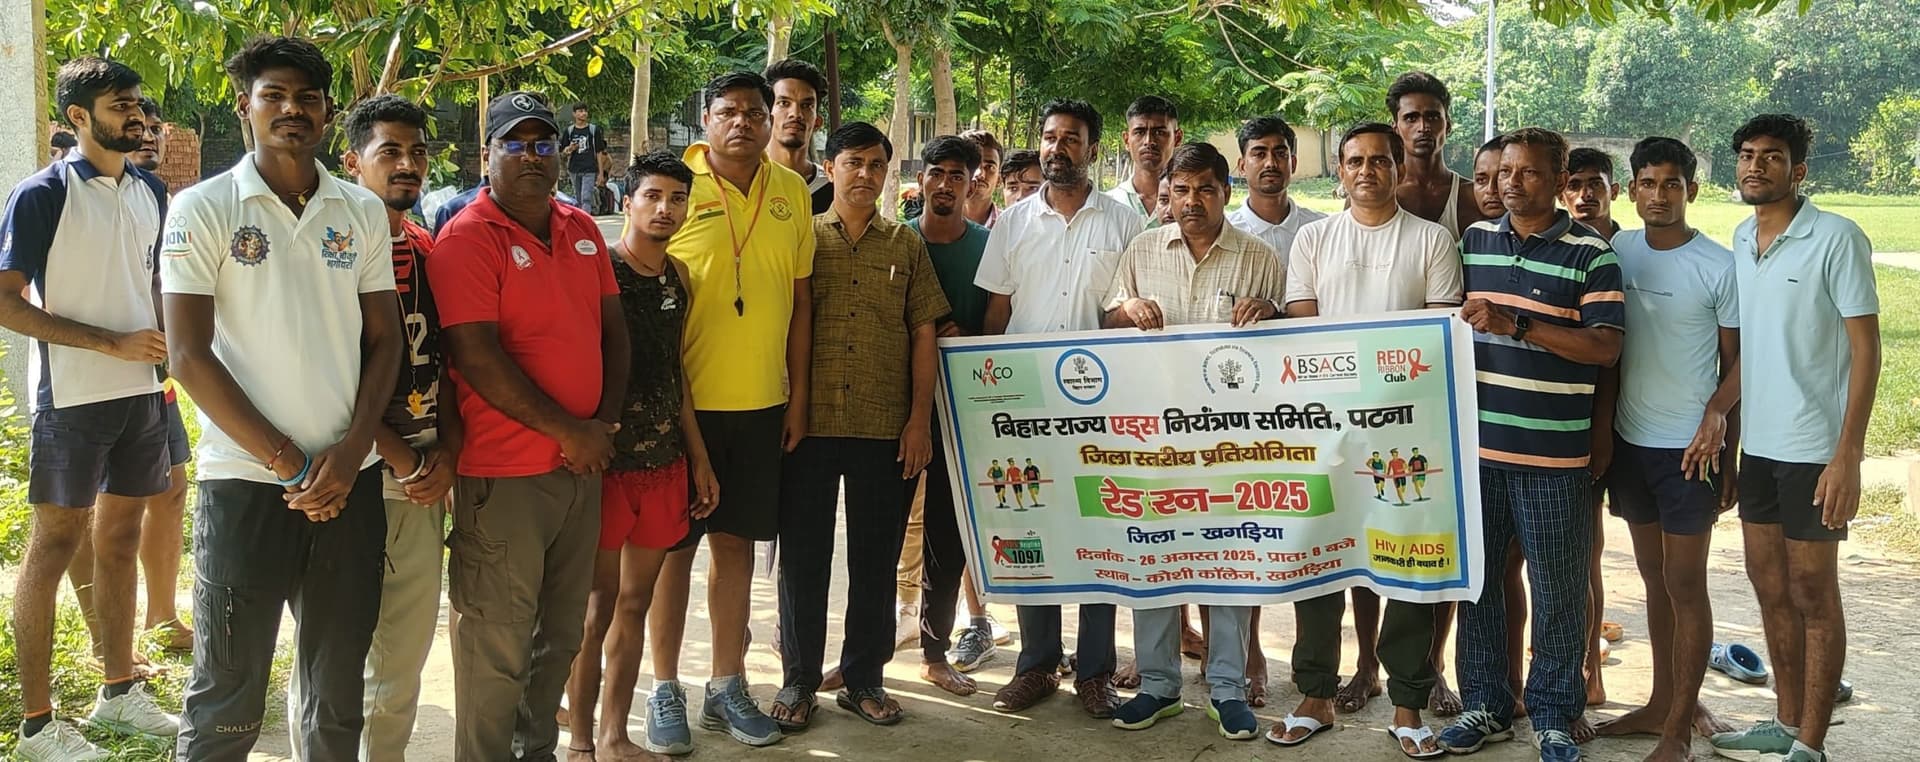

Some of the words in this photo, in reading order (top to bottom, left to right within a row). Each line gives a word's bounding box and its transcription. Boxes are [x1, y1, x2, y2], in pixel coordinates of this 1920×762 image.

[166, 231, 192, 245] INDI
[1298, 356, 1356, 374] BSACS
[1377, 350, 1406, 365] RED
[973, 359, 1013, 385] NACO
[1378, 365, 1406, 374] RIBBON
[1384, 374, 1407, 383] Club
[992, 412, 1051, 438] बिहार
[1054, 416, 1106, 436] राज्य
[1109, 416, 1160, 443] एड्स
[1163, 406, 1250, 435] नियंत्रण
[1253, 404, 1341, 431] समिति,
[1347, 405, 1414, 429] पटना
[1080, 445, 1131, 465] जिला
[1134, 446, 1196, 467] स्तरीय
[1200, 441, 1317, 467] प्रतियोगिता
[1100, 478, 1144, 518] रेड
[1127, 526, 1176, 544] जिला
[1200, 522, 1284, 543] खगड़िया
[1012, 549, 1041, 564] 1097
[1076, 548, 1124, 563] दिनांक
[1140, 555, 1156, 565] 26
[1161, 550, 1219, 563] अगस्त
[1222, 550, 1262, 562] 2025,
[1312, 546, 1321, 557] 8
[1325, 538, 1356, 553] बजे
[1375, 538, 1396, 554] HIV
[1409, 543, 1445, 555] AIDS
[1094, 569, 1129, 582] स्थान
[1145, 567, 1194, 583] कोशी
[1198, 567, 1262, 582] कॉलेज,
[1266, 559, 1342, 581] खगड़िया
